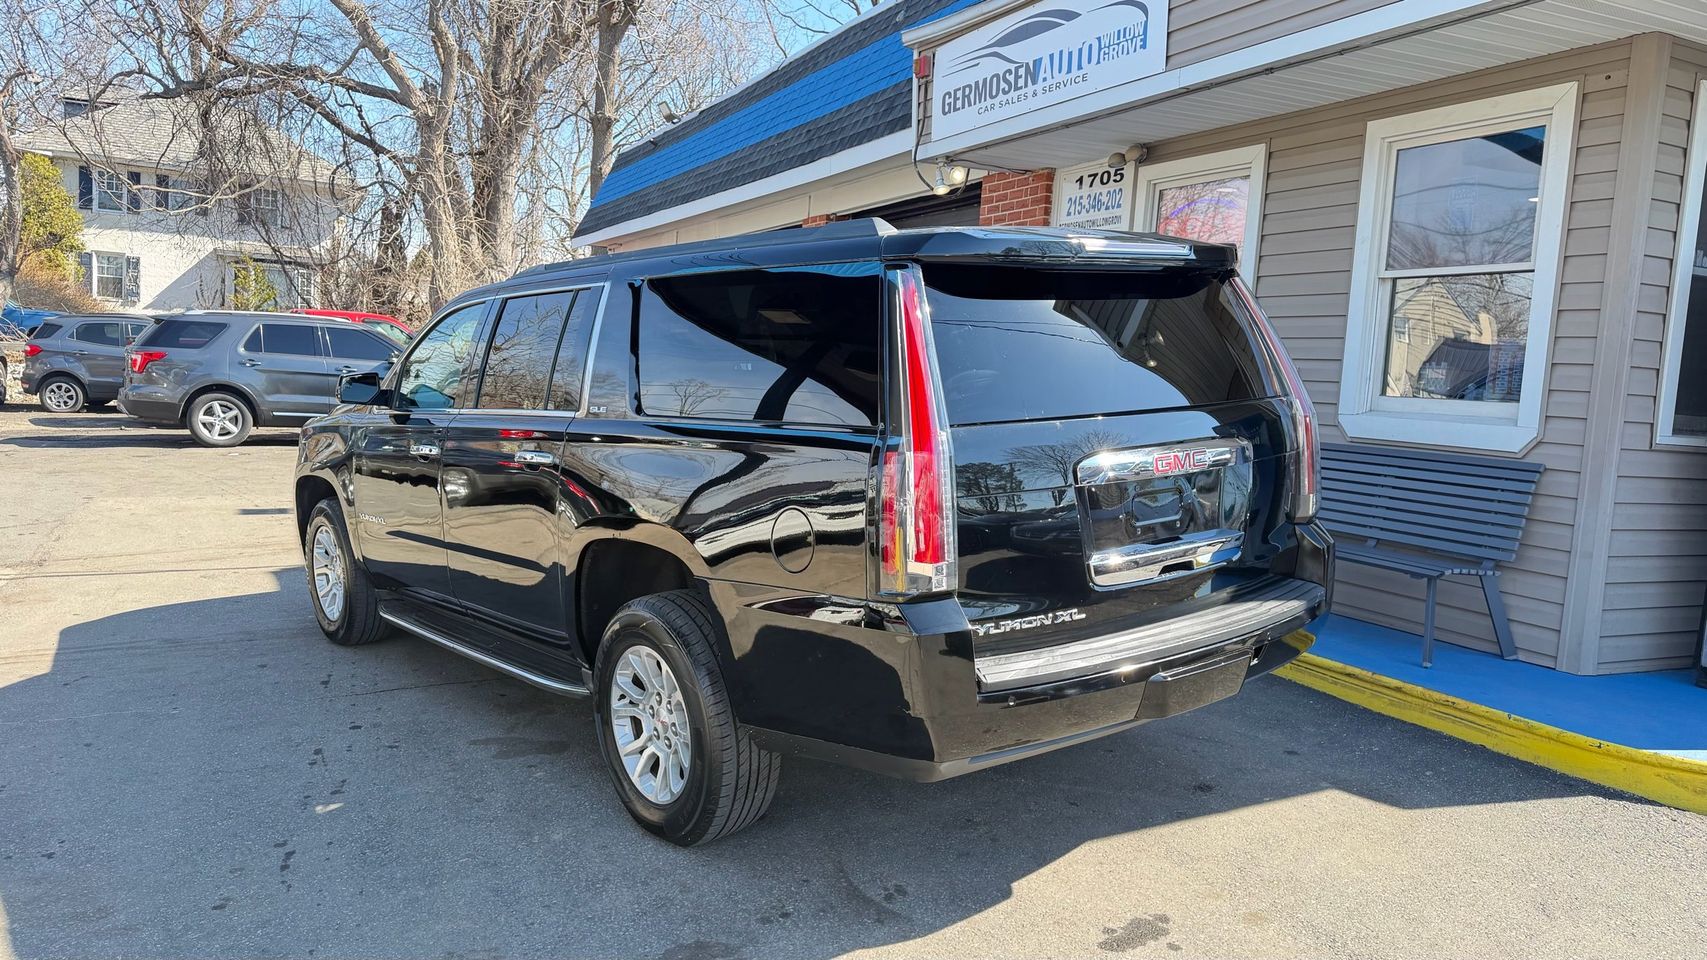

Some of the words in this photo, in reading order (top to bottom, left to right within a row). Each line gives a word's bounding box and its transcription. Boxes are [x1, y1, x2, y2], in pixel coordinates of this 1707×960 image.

[1100, 35, 1145, 61] GROVE
[1101, 20, 1145, 48] WILLOW
[941, 59, 1038, 117] GERMOSEN
[1036, 39, 1099, 81] AUTO
[977, 103, 995, 115] CAR
[998, 93, 1029, 109] SALES
[1031, 88, 1039, 98] &
[1041, 72, 1089, 94] SERVICE
[1075, 167, 1125, 190] 1705
[1153, 447, 1208, 475] GMC
[970, 613, 1053, 636] YUKON
[1054, 608, 1087, 624] XL
